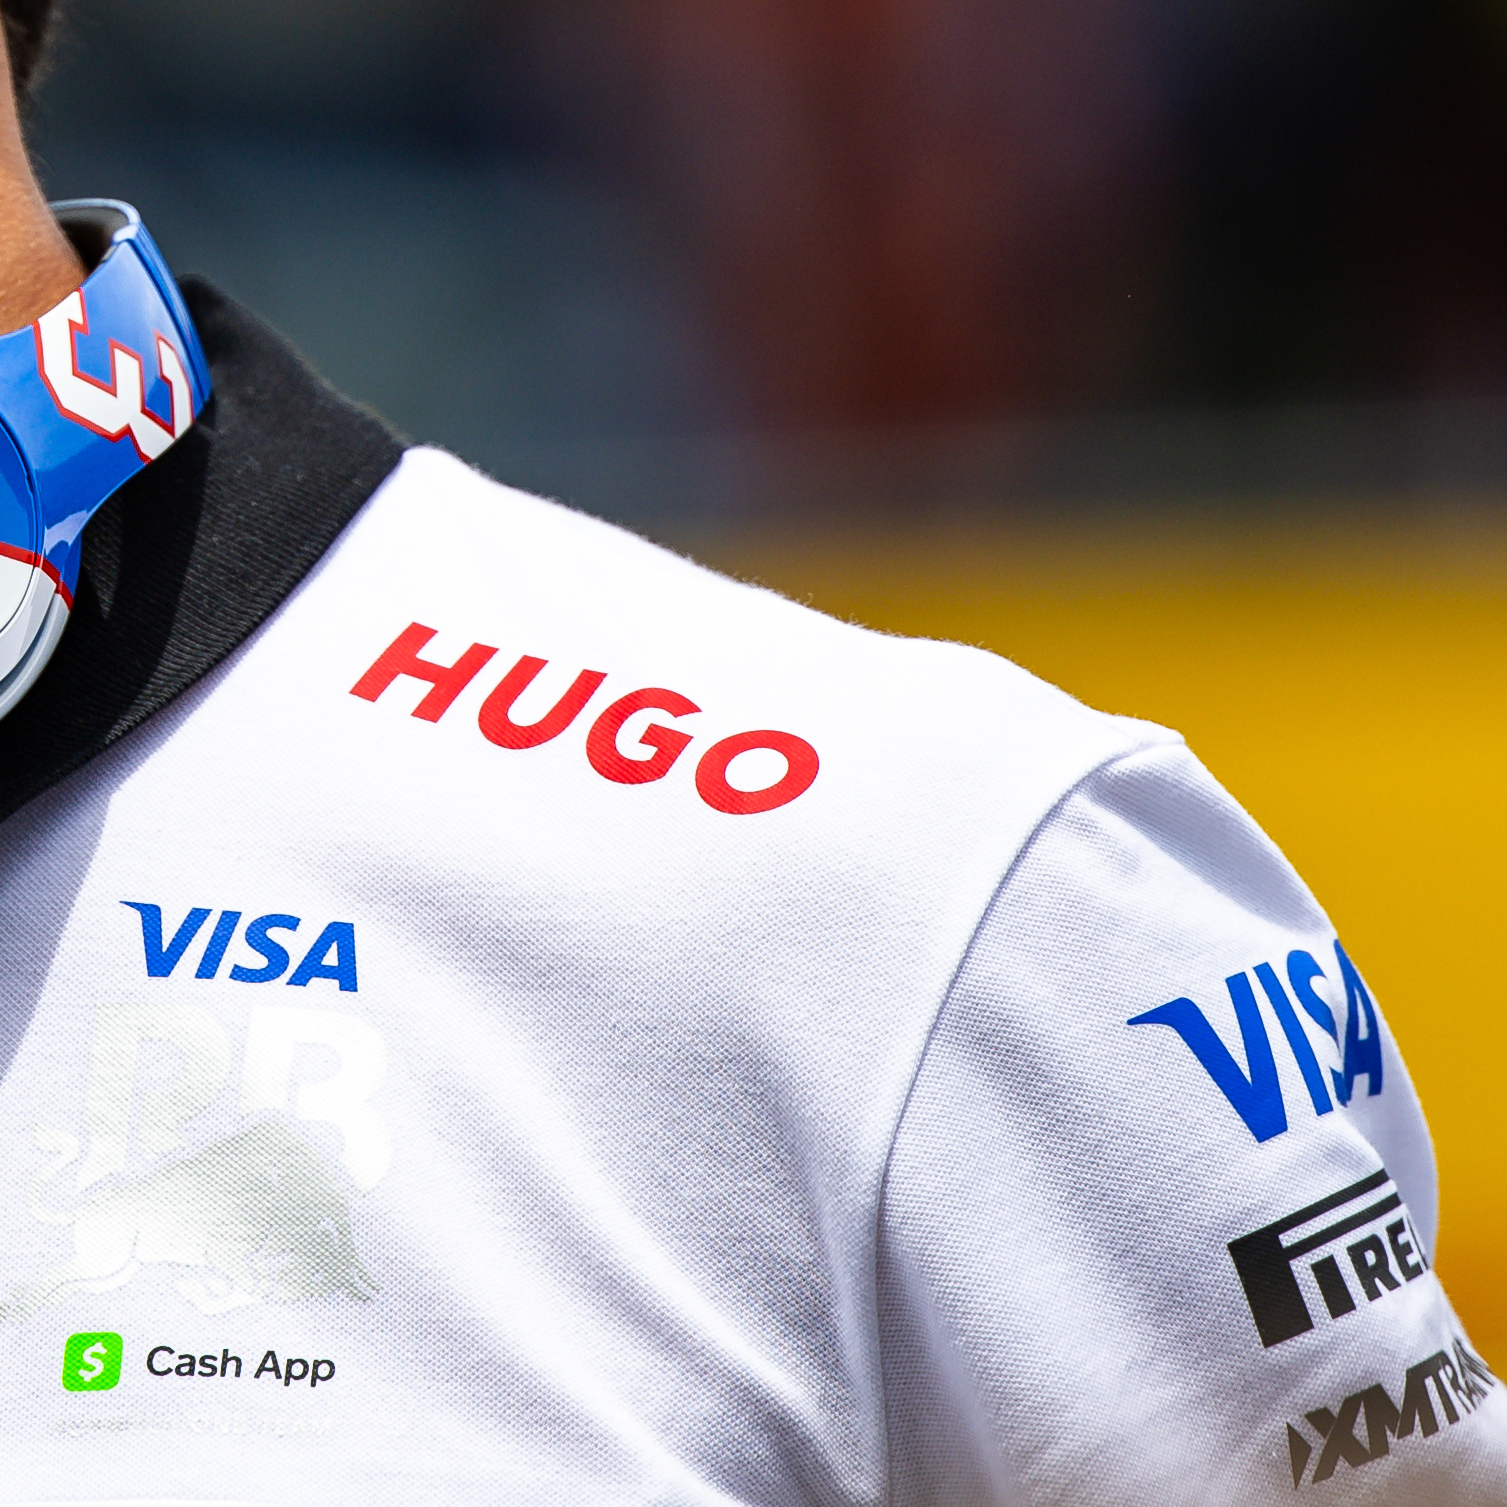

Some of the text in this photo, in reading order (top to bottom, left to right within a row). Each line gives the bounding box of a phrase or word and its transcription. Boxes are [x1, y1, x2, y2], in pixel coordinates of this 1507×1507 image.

[350, 622, 820, 815] HUGO
[119, 900, 358, 992] VISA
[1126, 938, 1383, 1143] VISA
[1227, 1168, 1432, 1349] PIRE
[146, 1346, 242, 1377] Cash
[254, 1350, 336, 1387] App
